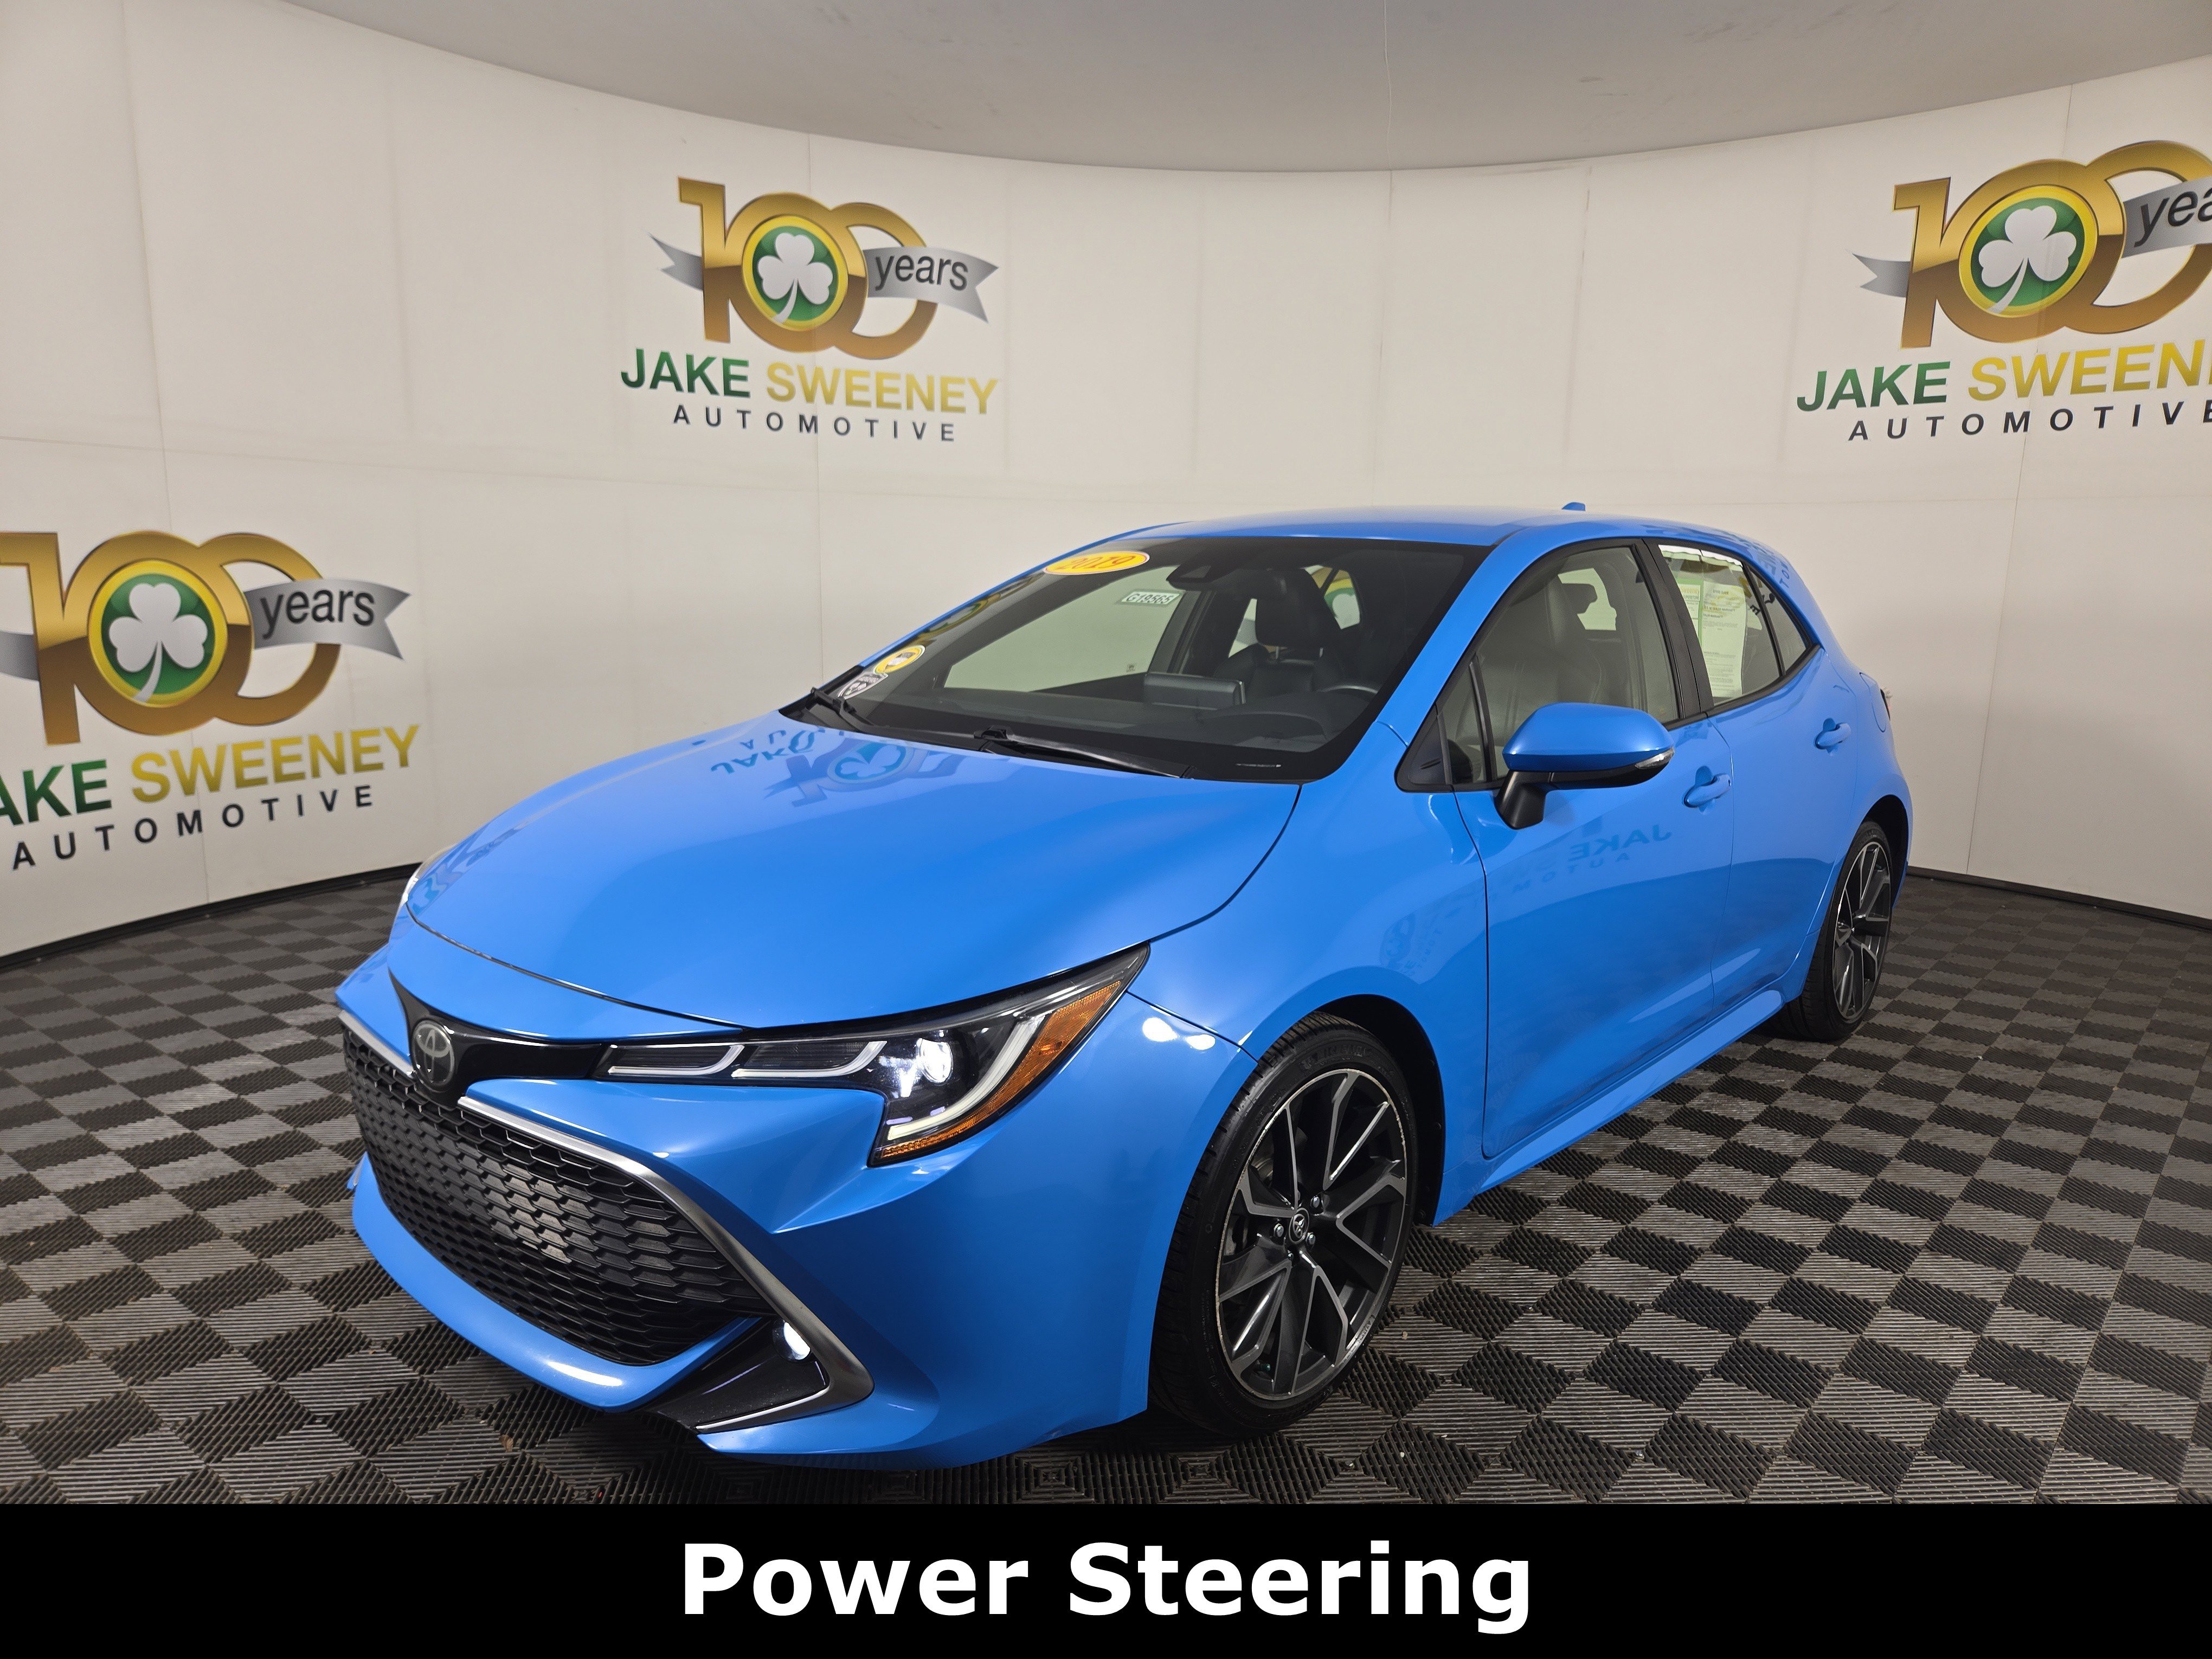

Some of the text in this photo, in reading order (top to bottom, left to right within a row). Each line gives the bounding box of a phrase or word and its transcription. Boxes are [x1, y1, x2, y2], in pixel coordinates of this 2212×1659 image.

[678, 177, 969, 360] 100 years
[1893, 140, 2212, 349] 100
[621, 348, 999, 415] JAKE SWEENEY
[1796, 338, 2212, 412] JAKE SWEEN
[673, 404, 955, 441] AUTOMOTIVE
[1056, 555, 1136, 570] 2019
[0, 530, 375, 746] 100 years
[131, 724, 420, 803] SWEENEY
[12, 785, 373, 871] AUTOMOTIVE
